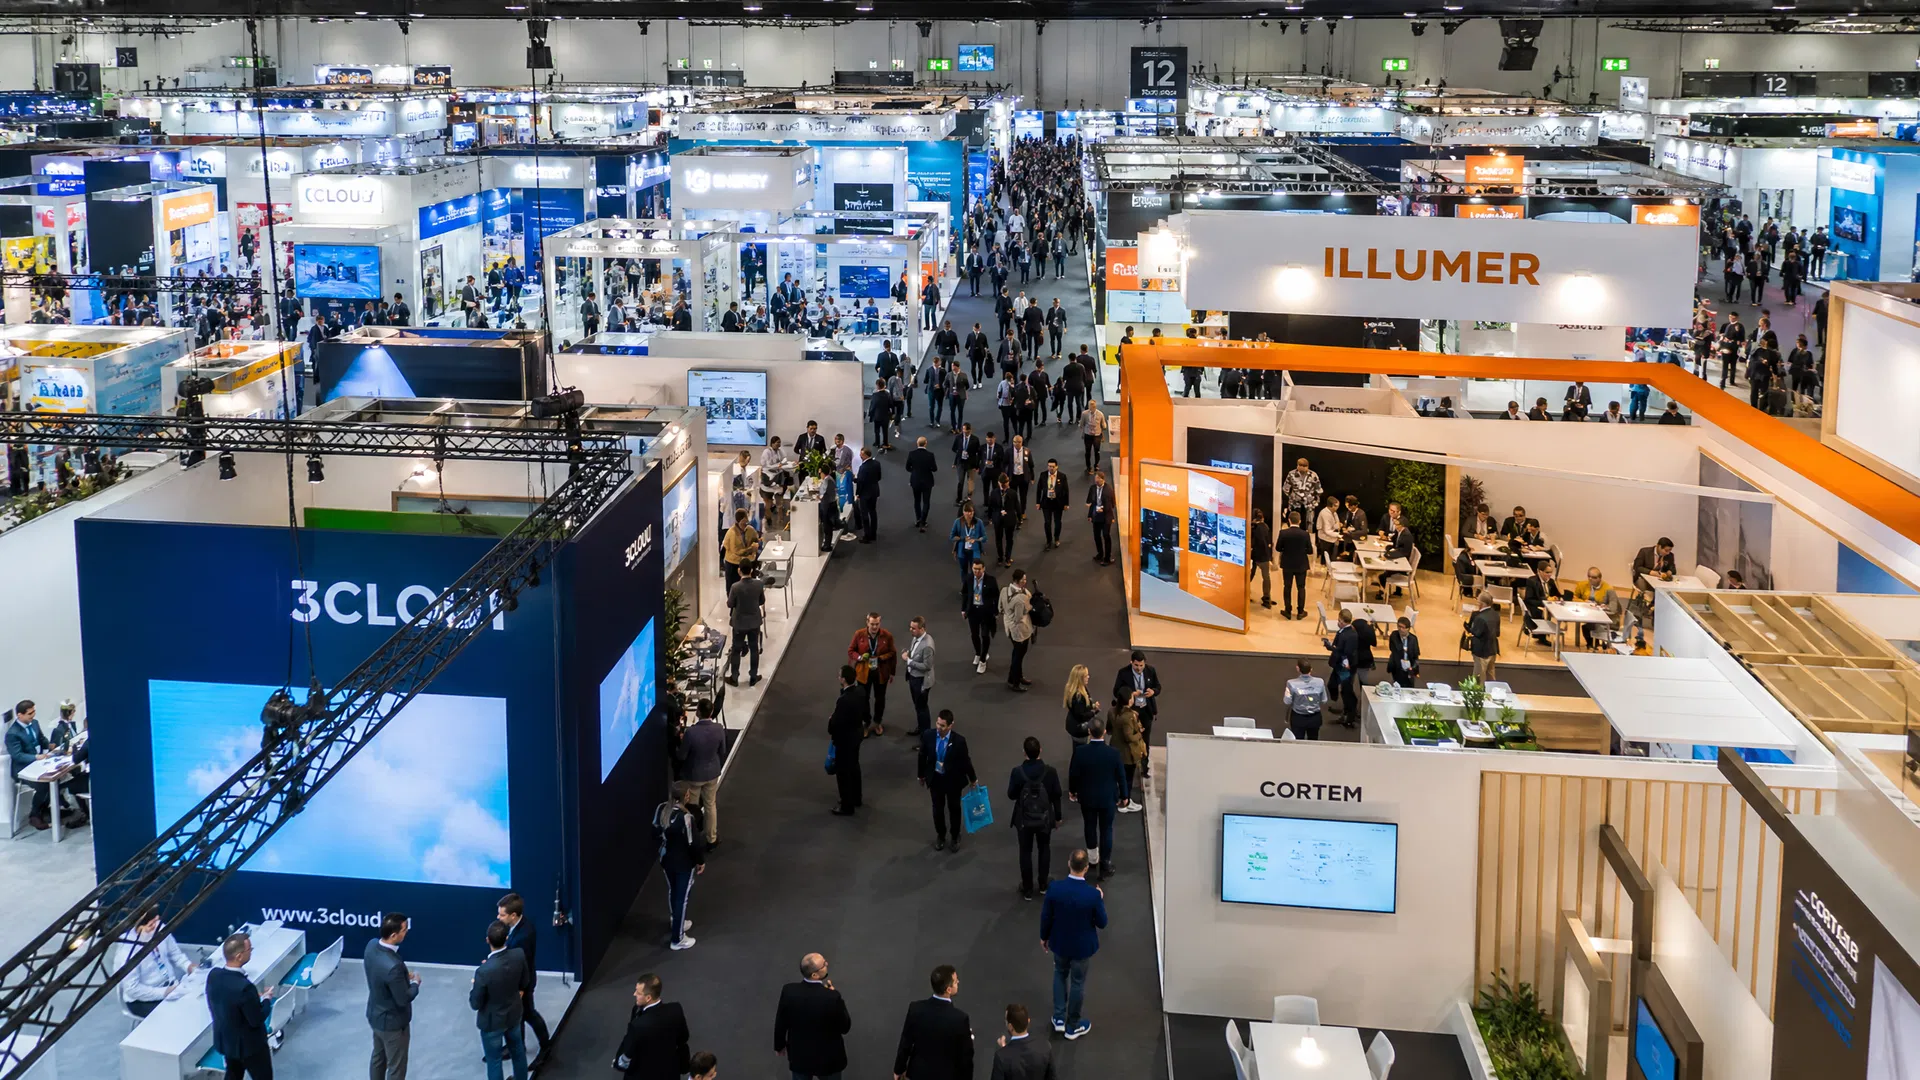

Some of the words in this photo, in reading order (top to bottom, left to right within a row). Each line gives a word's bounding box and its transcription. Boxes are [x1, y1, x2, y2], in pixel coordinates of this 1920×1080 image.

[65, 71, 88, 91] 12
[1143, 60, 1175, 87] 12
[1766, 77, 1787, 92] 12
[1324, 247, 1540, 286] ILLUMER
[1260, 781, 1362, 803] CORTEM
